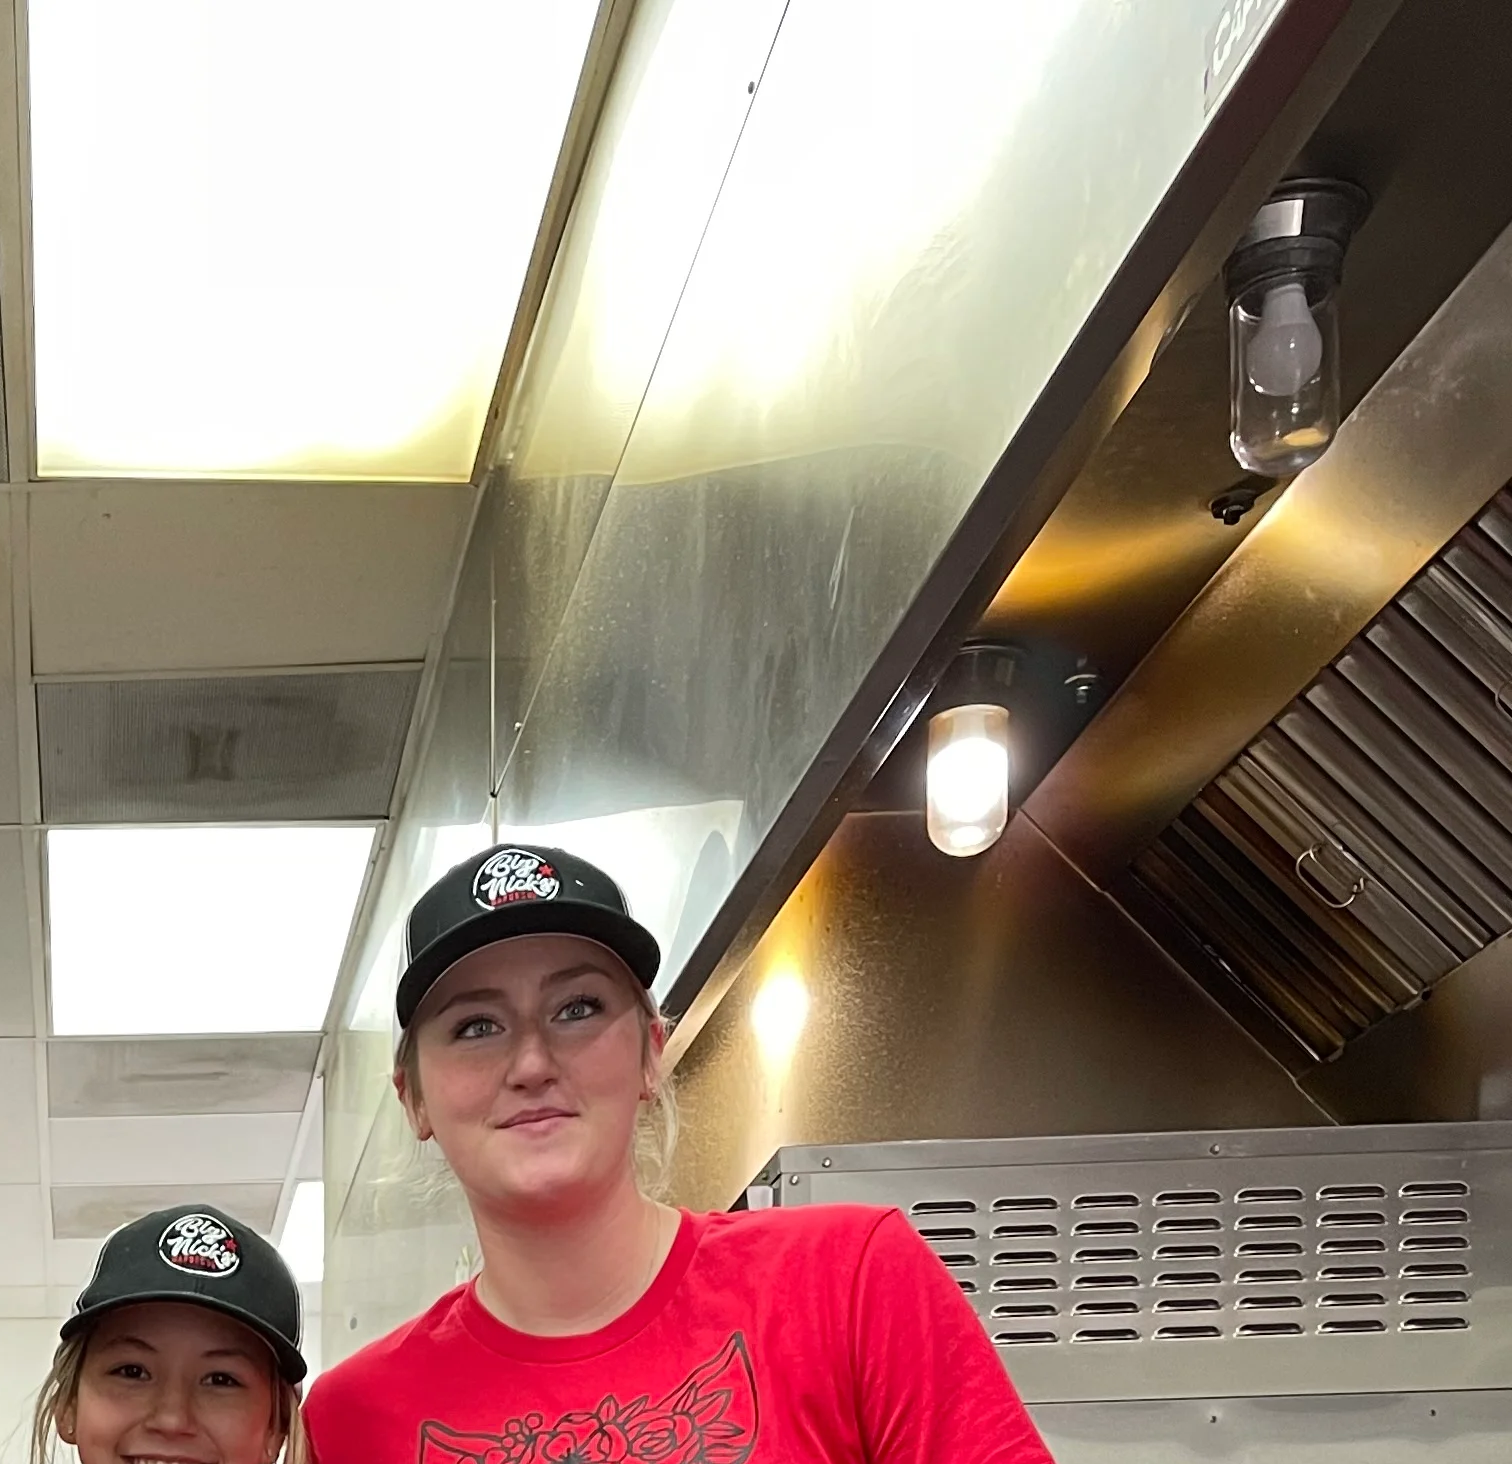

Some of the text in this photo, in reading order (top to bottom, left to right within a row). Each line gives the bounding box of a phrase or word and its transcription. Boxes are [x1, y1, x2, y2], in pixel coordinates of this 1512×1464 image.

[484, 854, 540, 878] Big
[480, 873, 557, 902] Nick's
[175, 1217, 228, 1245] Big
[166, 1237, 237, 1270] Nick's
